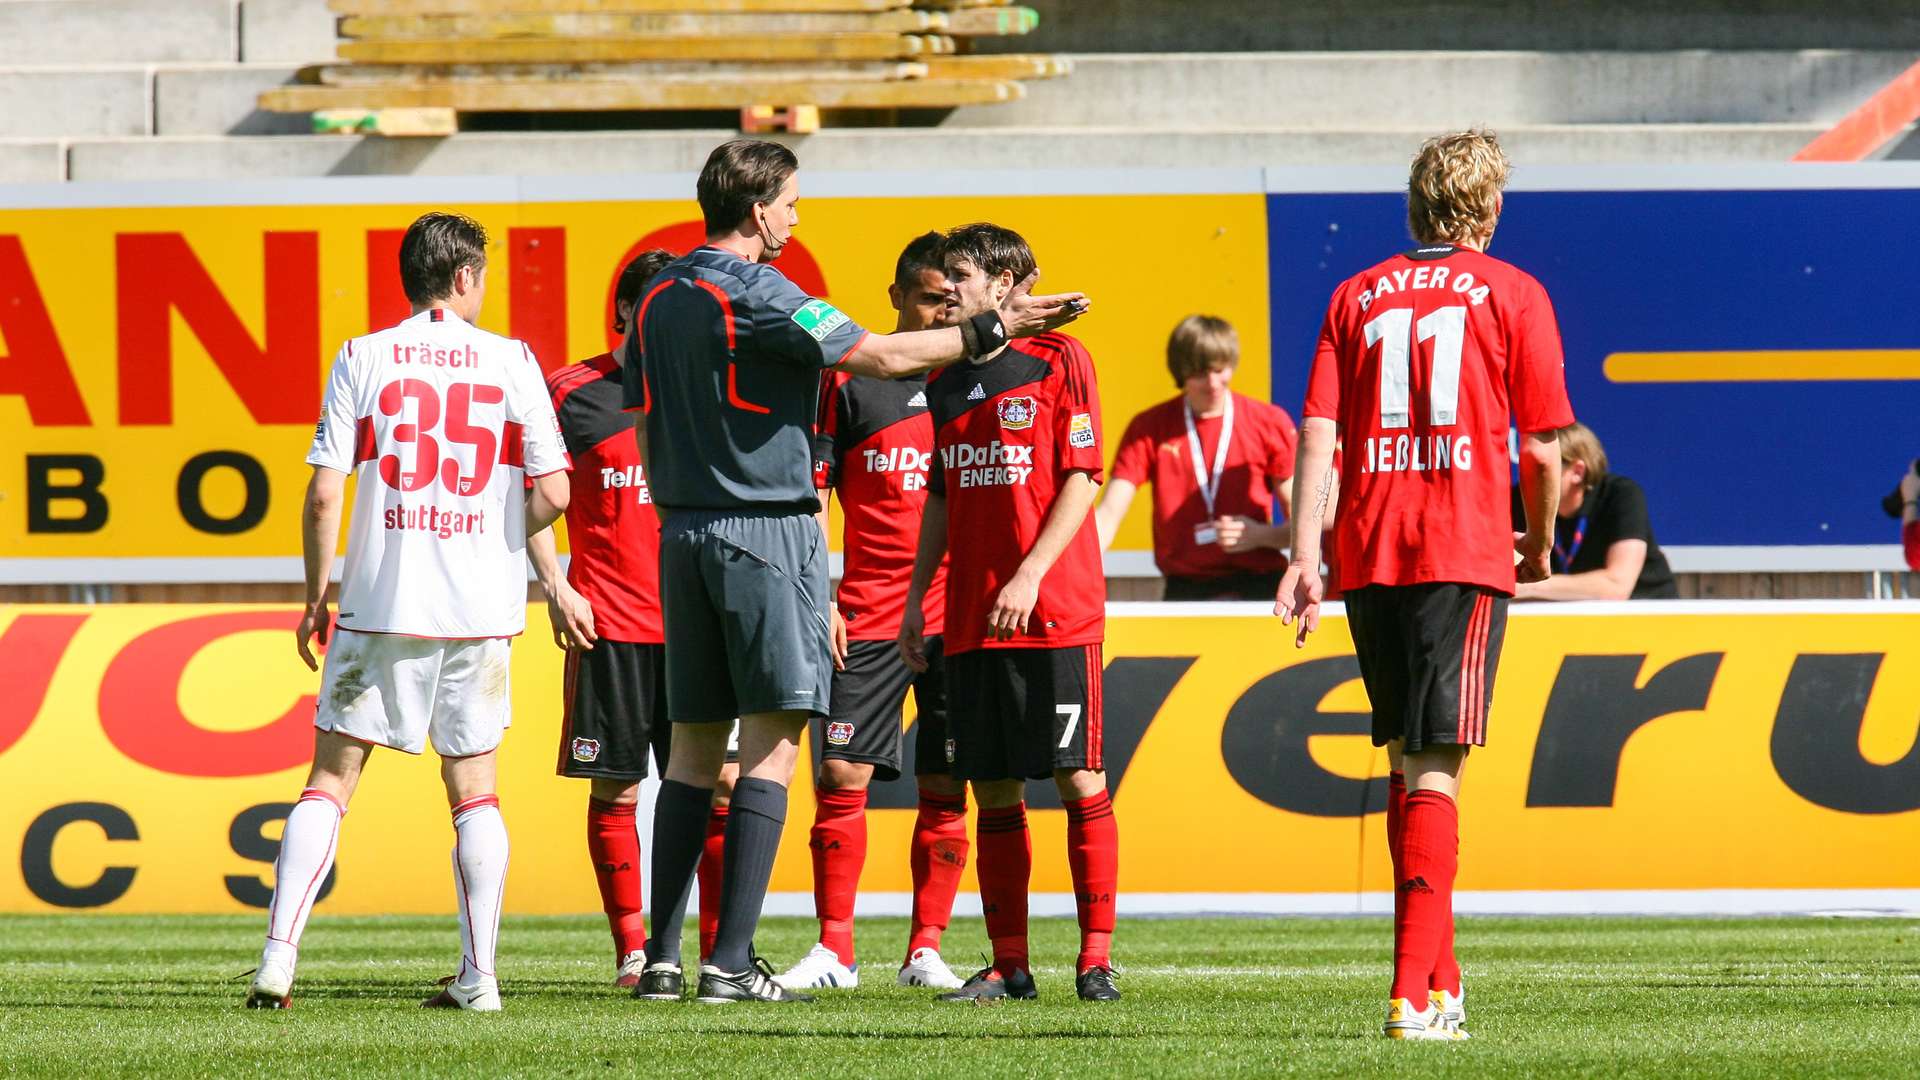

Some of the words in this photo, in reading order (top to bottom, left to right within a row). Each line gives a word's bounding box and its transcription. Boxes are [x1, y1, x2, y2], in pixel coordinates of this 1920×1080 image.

[1358, 266, 1450, 312] BAYER
[1452, 272, 1490, 306] 04
[393, 343, 478, 368] träsch
[1363, 306, 1467, 429] 11
[378, 378, 504, 497] 35
[1071, 433, 1092, 444] LIGA
[1361, 434, 1472, 473] IEßLING
[959, 466, 1033, 488] ENERGY
[385, 503, 485, 539] stuttgart
[1056, 704, 1081, 748] 7
